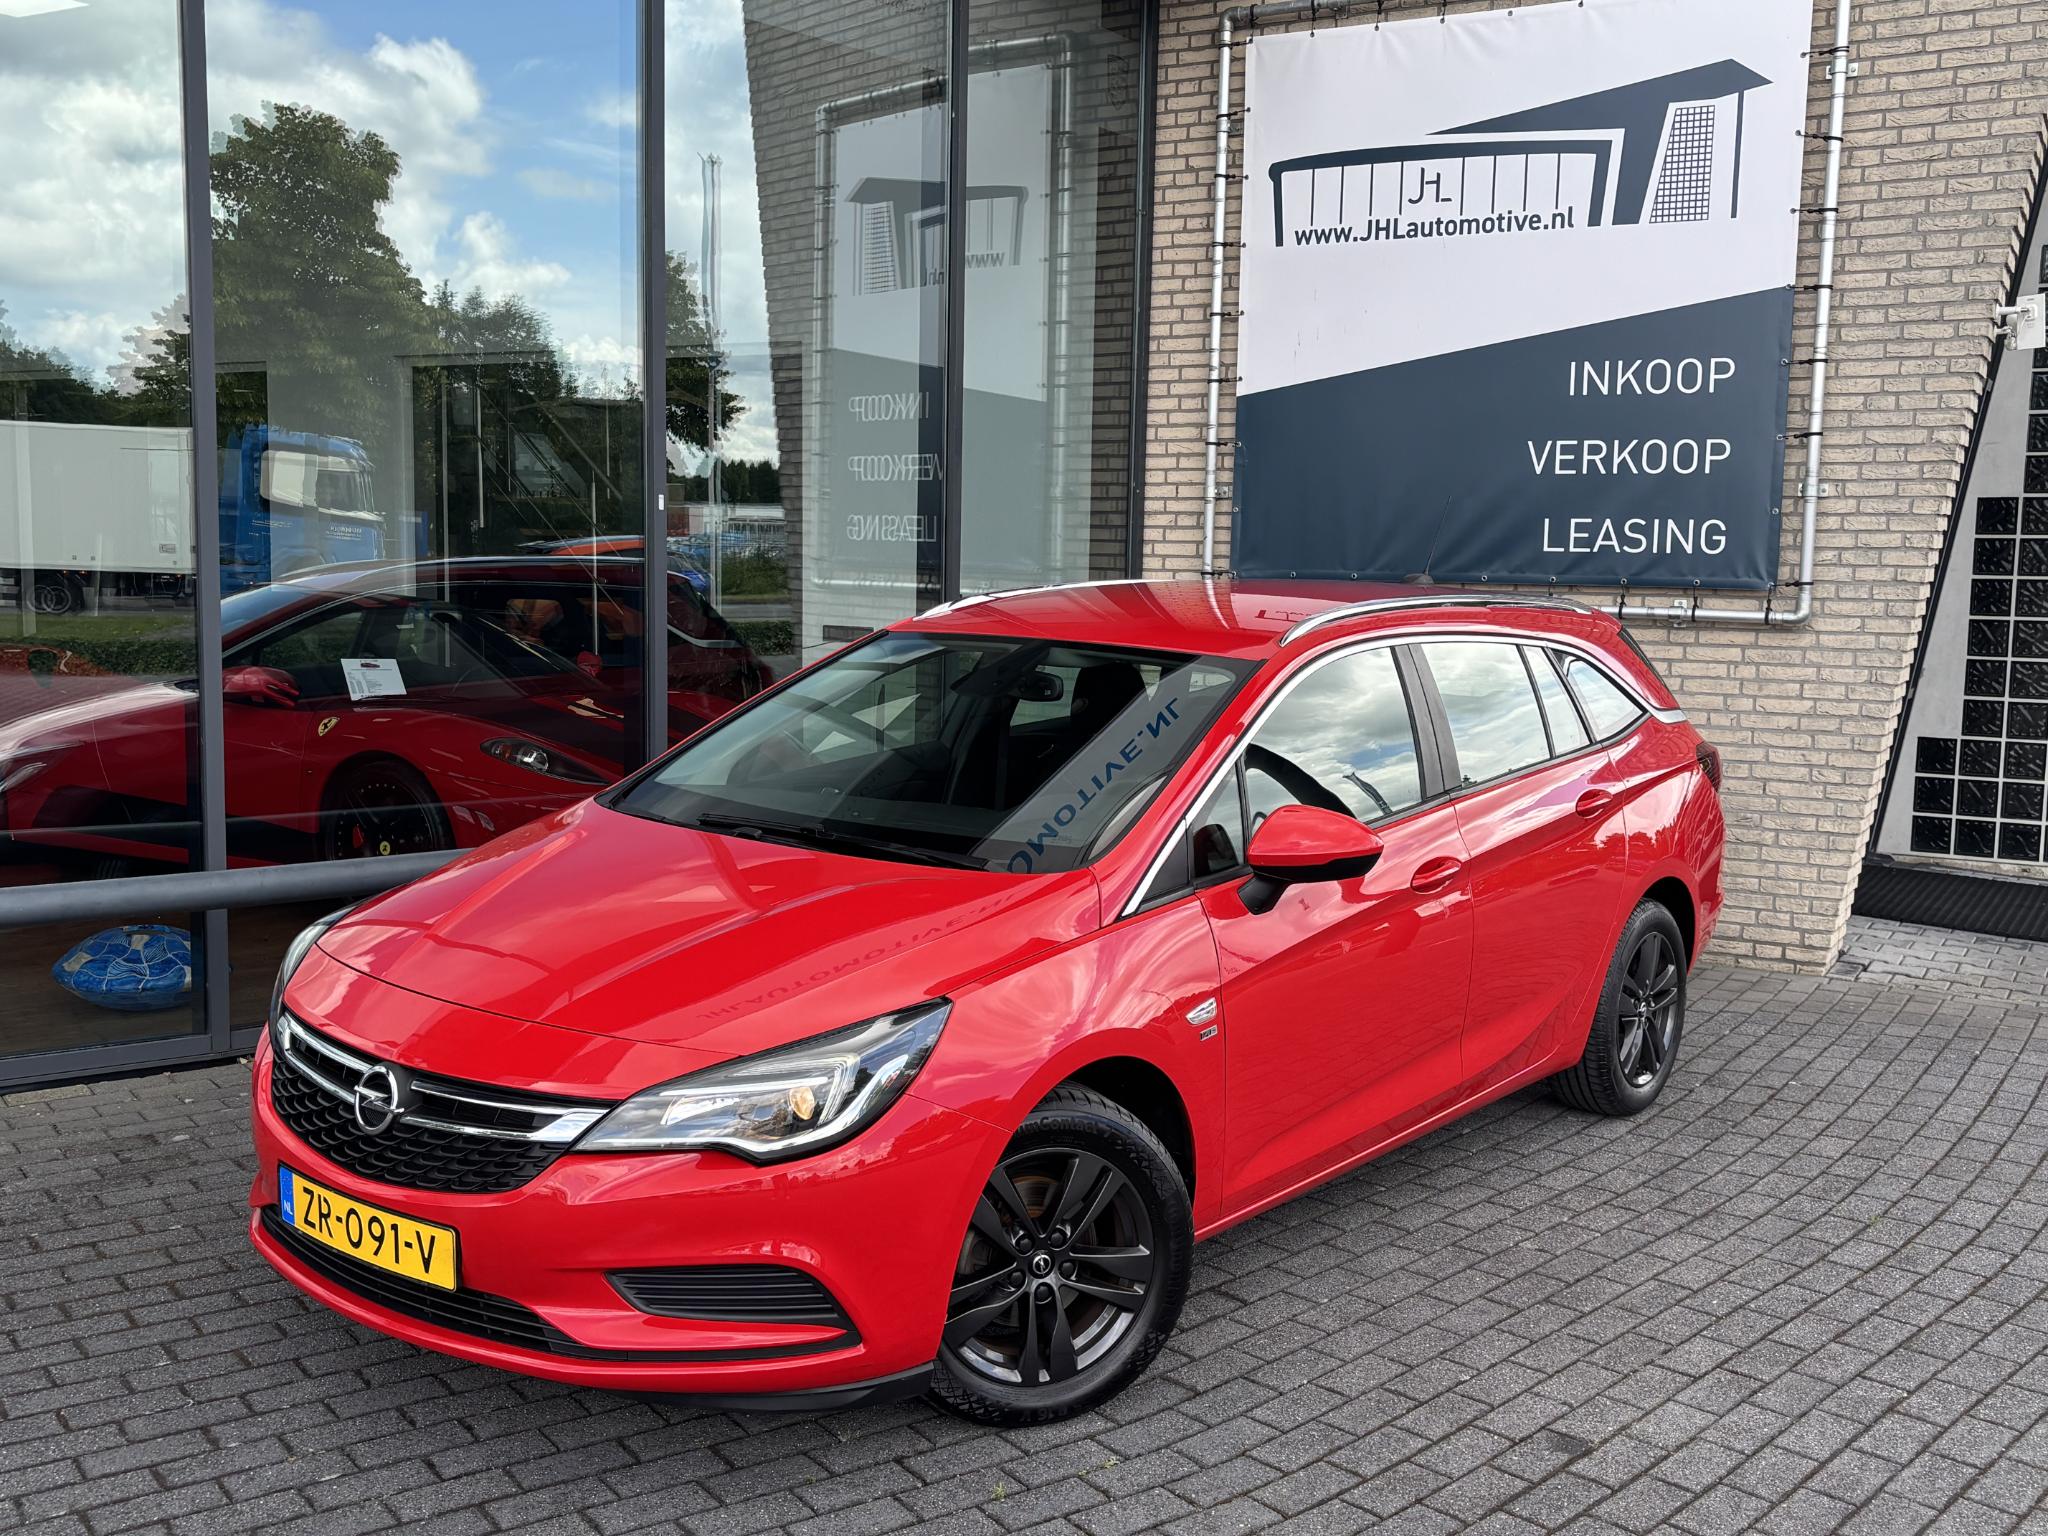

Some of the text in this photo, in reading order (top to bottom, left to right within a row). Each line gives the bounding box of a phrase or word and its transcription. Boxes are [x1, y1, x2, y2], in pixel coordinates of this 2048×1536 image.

[1408, 167, 1453, 205] JHL
[1294, 206, 1574, 246] www.JHLautomotive.nl
[1568, 357, 1736, 396] INKOOP
[1527, 439, 1731, 476] VERKOOP
[1541, 517, 1727, 555] LEASING
[283, 1199, 294, 1215] NL
[302, 1186, 436, 1274] ZR-091-V
